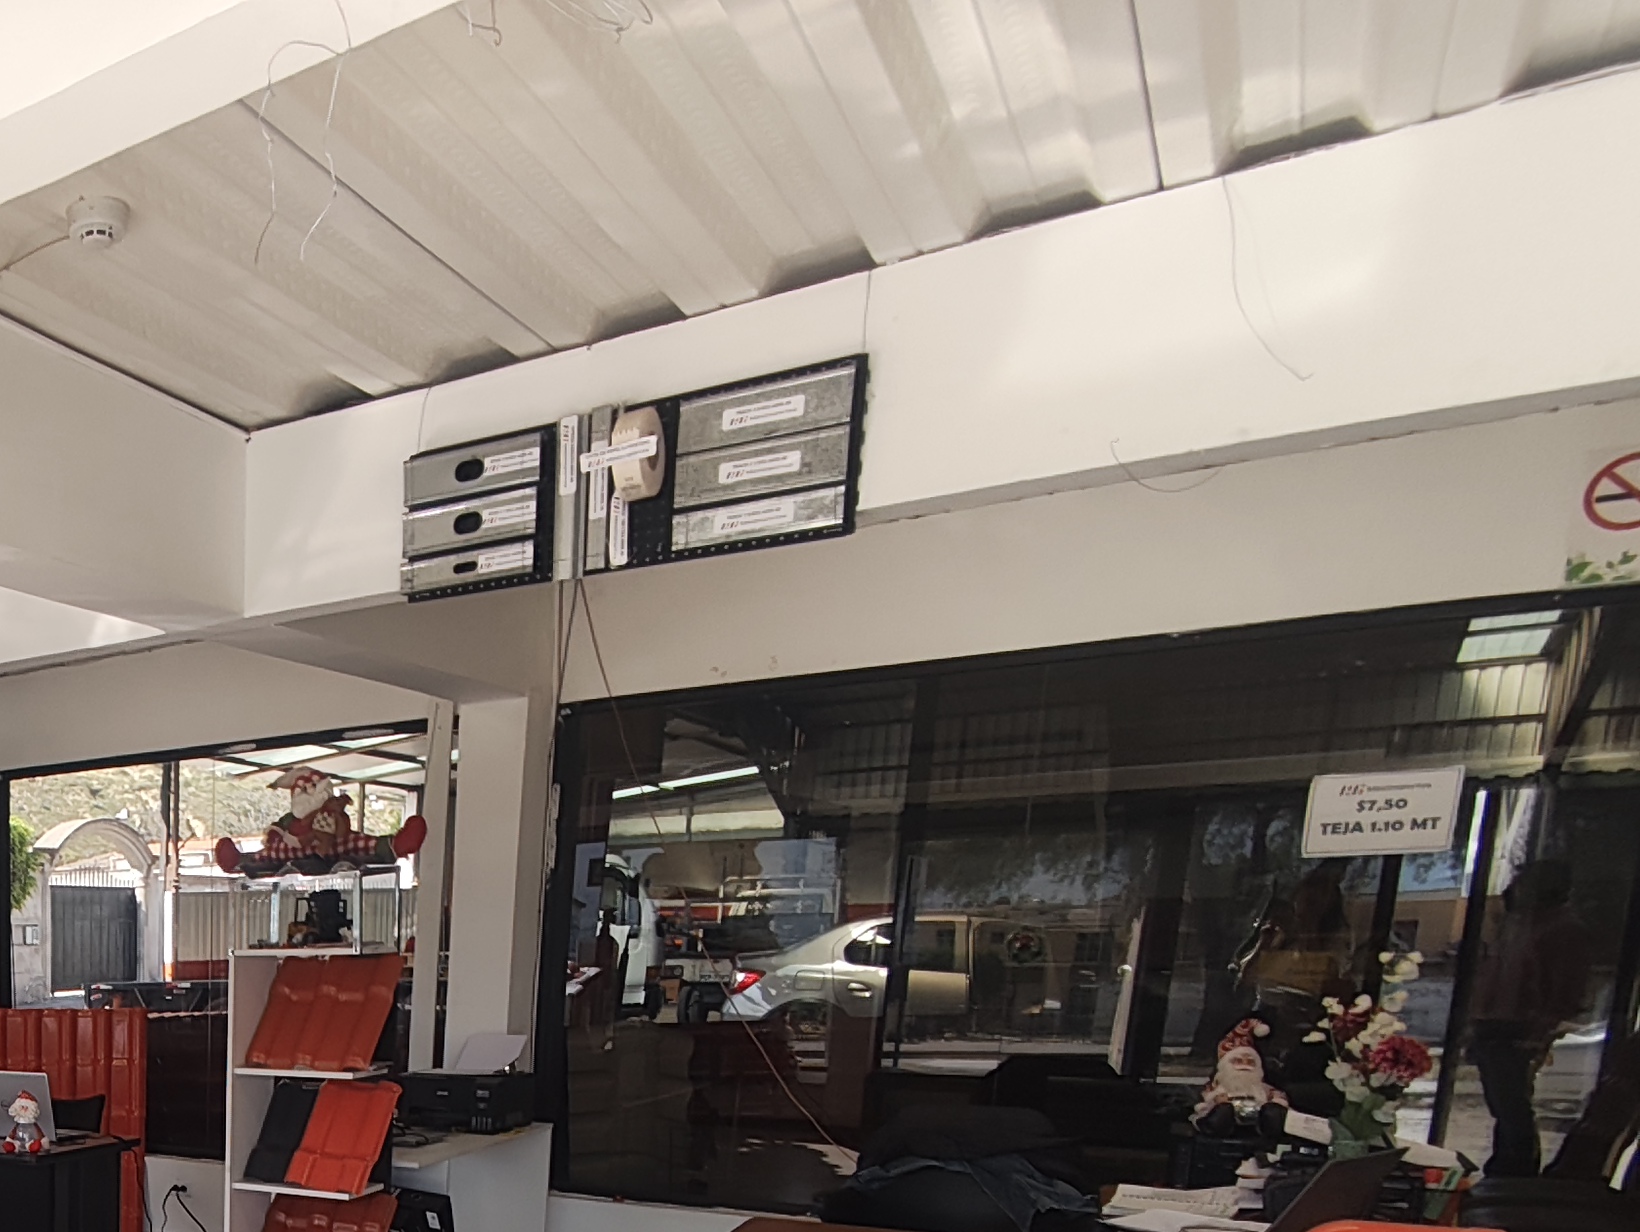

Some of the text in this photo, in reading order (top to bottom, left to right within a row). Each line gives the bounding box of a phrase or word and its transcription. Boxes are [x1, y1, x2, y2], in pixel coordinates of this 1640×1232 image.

[1320, 816, 1442, 835] TEJA 1.10 MT
